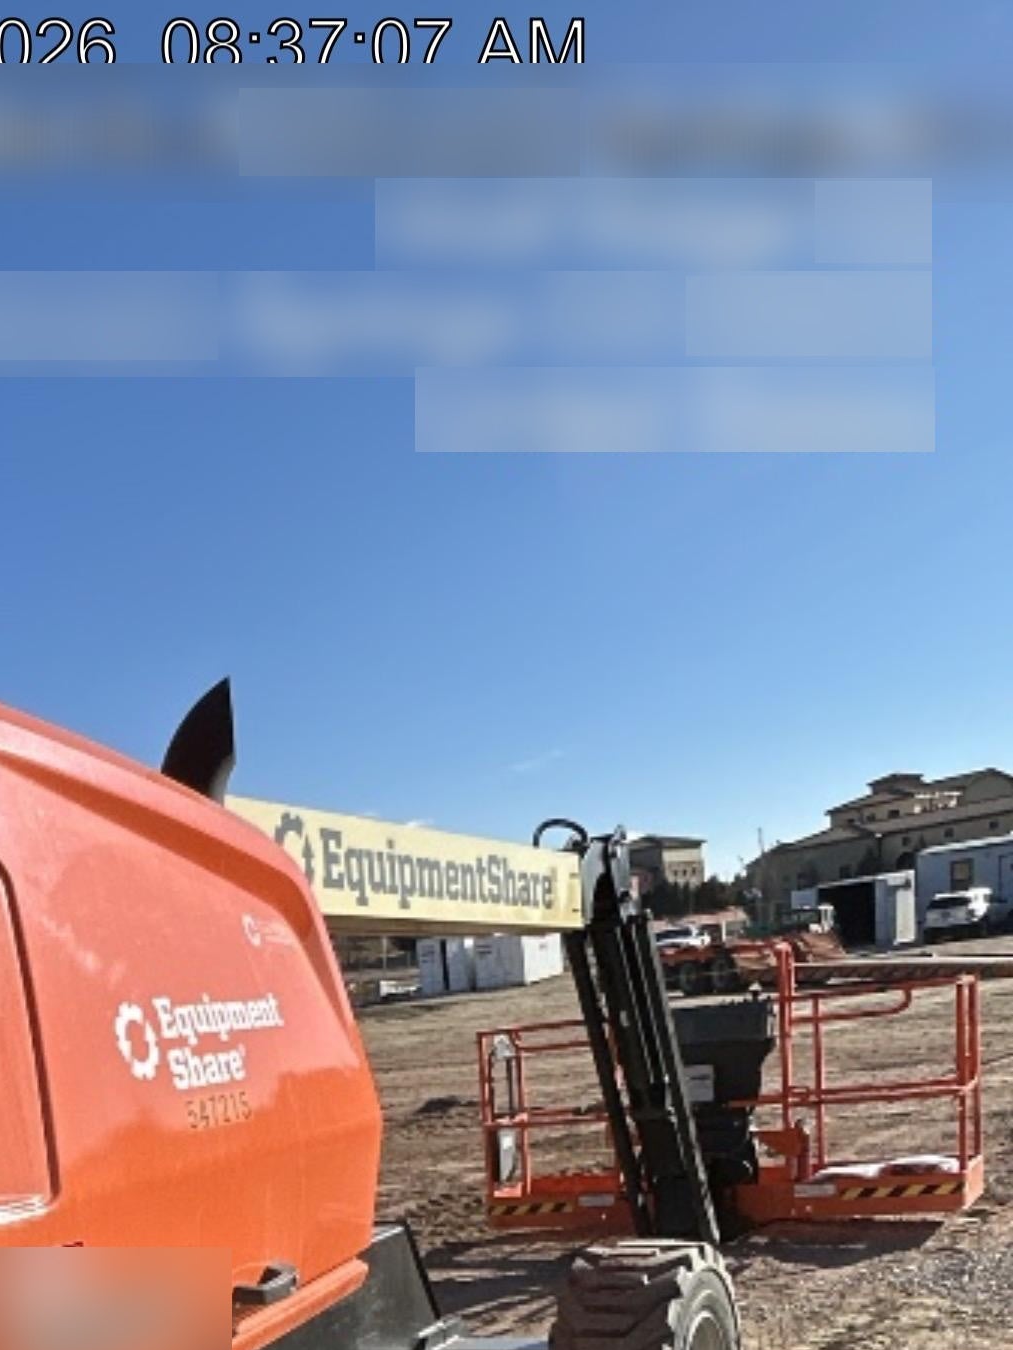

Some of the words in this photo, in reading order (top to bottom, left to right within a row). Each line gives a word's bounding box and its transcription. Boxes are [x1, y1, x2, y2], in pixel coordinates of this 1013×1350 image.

[319, 827, 556, 909] EquipmentShare
[151, 992, 284, 1046] Equipment
[167, 1046, 246, 1090] Share
[186, 1091, 252, 1129] 547215
